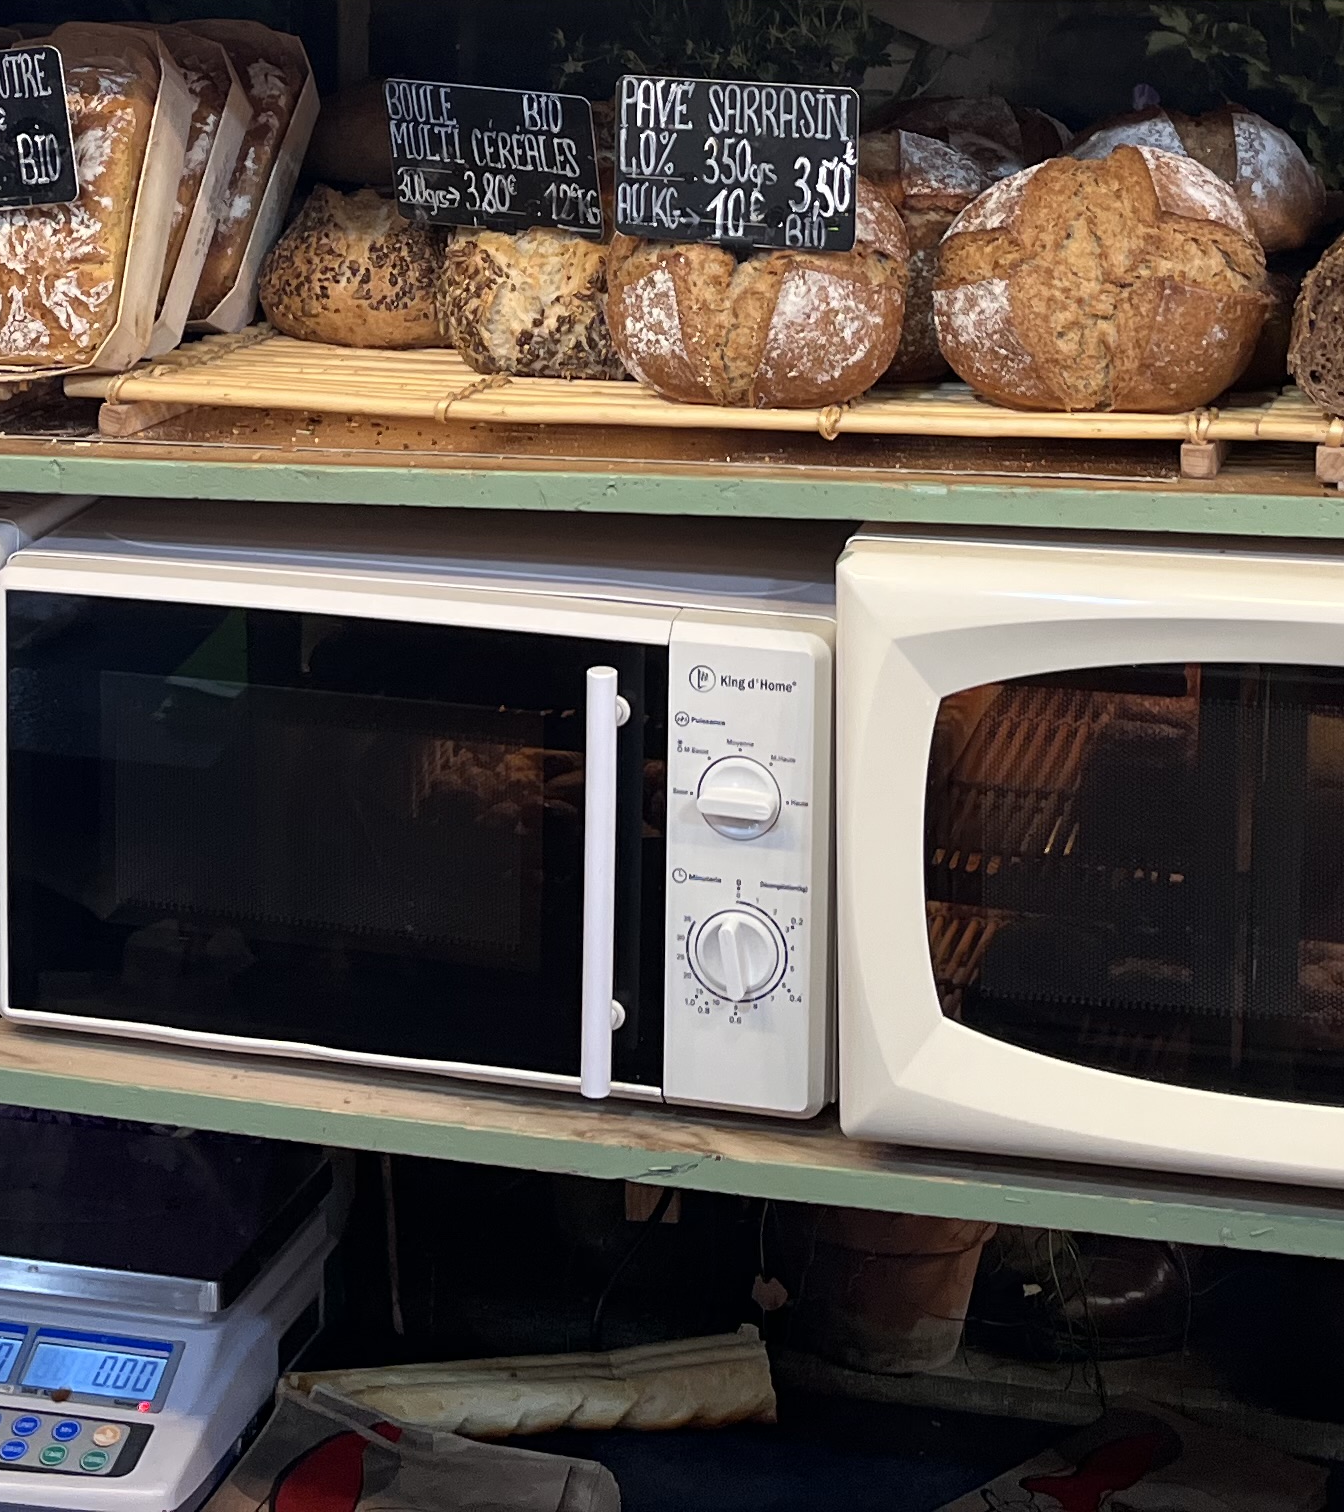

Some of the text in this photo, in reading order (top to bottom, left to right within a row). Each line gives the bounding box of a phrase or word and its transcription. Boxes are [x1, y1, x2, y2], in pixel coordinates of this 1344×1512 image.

[384, 81, 564, 134] BOULE BIO
[707, 84, 853, 142] SARRASIN
[16, 123, 61, 185] BIO
[389, 118, 581, 178] MULTI CÉRÉALES
[577, 188, 601, 225] KG
[618, 182, 650, 224] AU
[652, 186, 681, 230] KG
[720, 674, 746, 691] King
[684, 998, 696, 1006] 1.0
[789, 994, 803, 1003] 0.4
